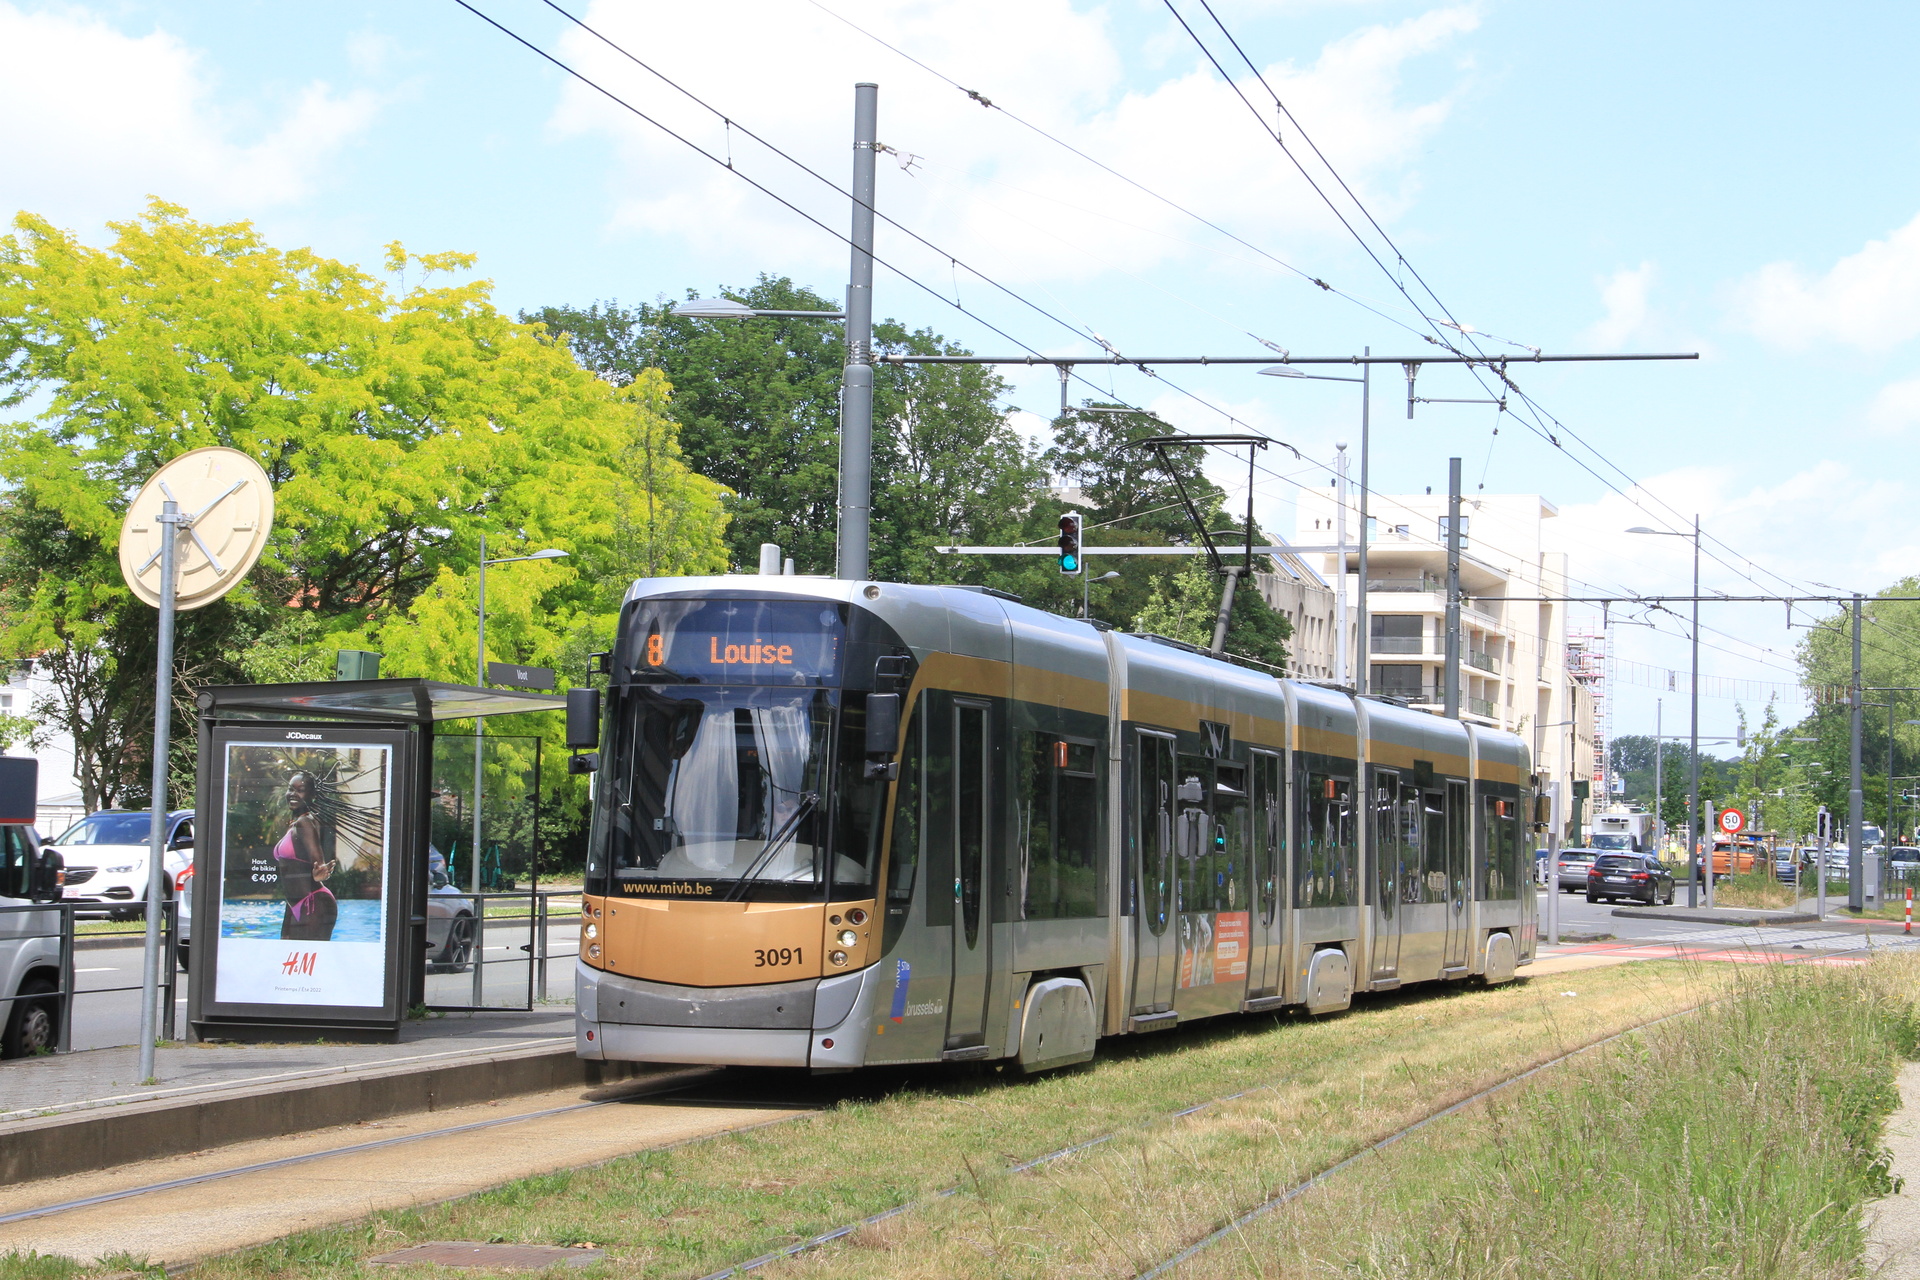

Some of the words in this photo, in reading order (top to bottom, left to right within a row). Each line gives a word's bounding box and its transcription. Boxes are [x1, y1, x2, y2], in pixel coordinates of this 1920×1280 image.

[648, 634, 664, 667] 8
[710, 636, 793, 665] Louise
[285, 731, 323, 740] JCDecaux
[1725, 815, 1738, 824] 50
[259, 873, 278, 884] 4,99
[623, 881, 713, 895] www.mivb.be
[281, 951, 317, 976] H&M
[754, 947, 803, 967] 3091
